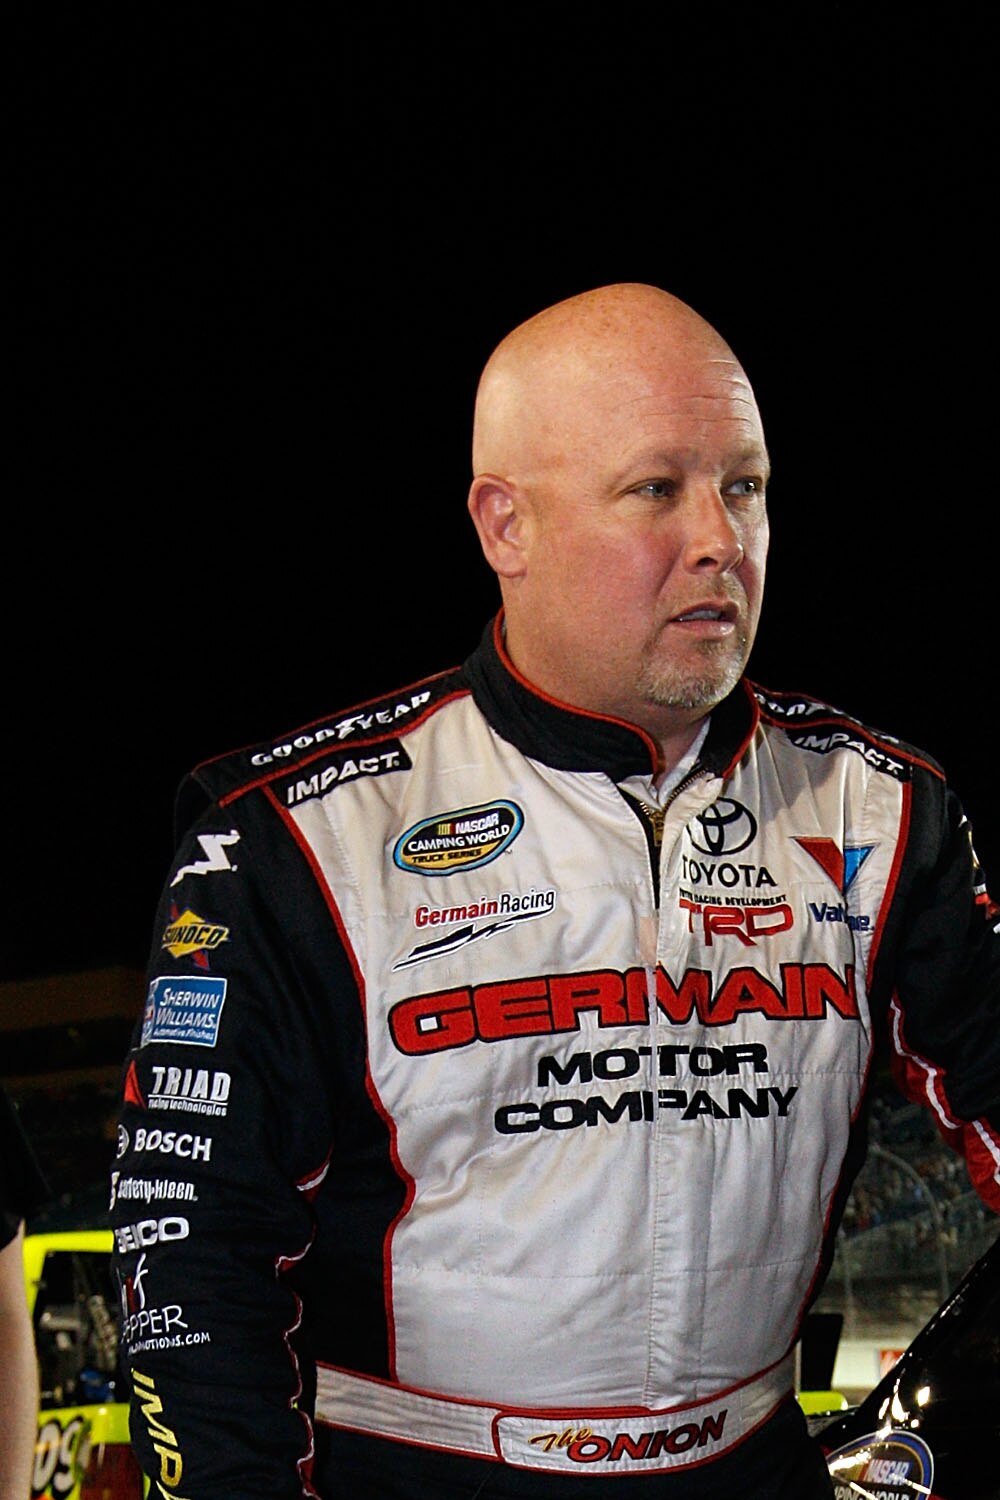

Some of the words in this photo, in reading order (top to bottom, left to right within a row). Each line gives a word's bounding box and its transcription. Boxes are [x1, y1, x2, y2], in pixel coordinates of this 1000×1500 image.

[251, 691, 431, 766] GOODYEAR
[407, 835, 466, 853] CAMPING
[466, 824, 511, 846] WORLD
[455, 811, 500, 835] NASCAR
[411, 852, 446, 864] TRUCK
[446, 848, 483, 861] SERIES
[681, 854, 779, 888] TOYOTA
[162, 923, 229, 949] SUNOCO
[679, 897, 794, 947] TRD
[160, 987, 221, 1009] SHERWIN
[387, 962, 861, 1057] GERMAIN
[537, 1042, 769, 1088] MOTOR
[152, 1065, 232, 1102] TRIAD
[494, 1085, 799, 1136] COMPANY
[134, 1128, 213, 1161] BOSCH
[528, 1425, 592, 1453] The
[567, 1408, 729, 1464] ONION
[862, 1457, 911, 1486] NASCAR
